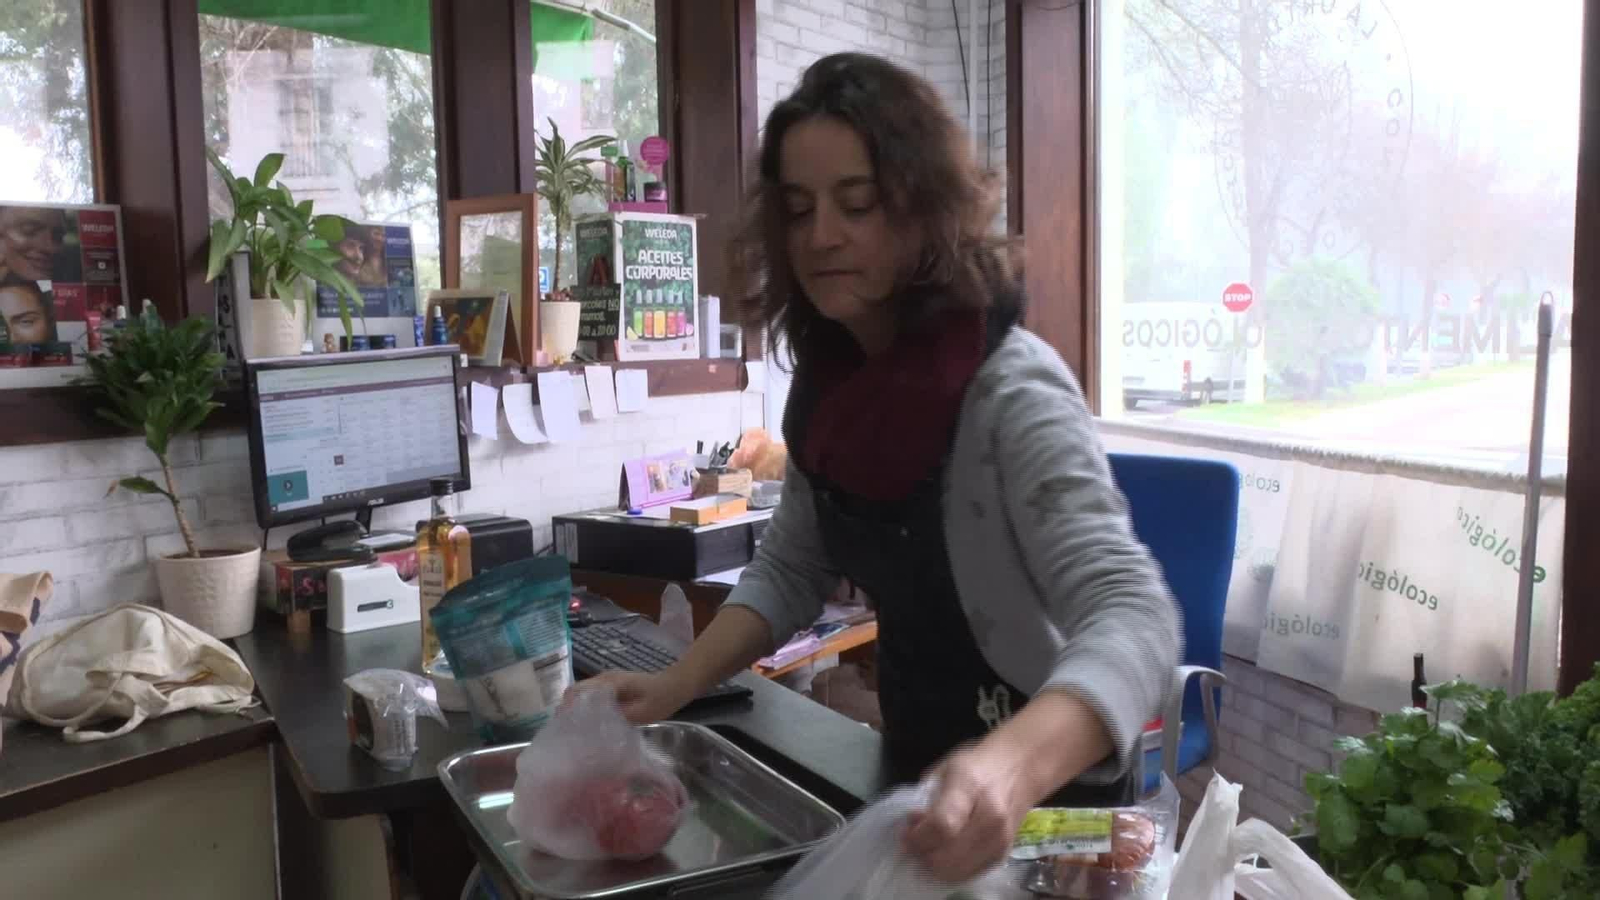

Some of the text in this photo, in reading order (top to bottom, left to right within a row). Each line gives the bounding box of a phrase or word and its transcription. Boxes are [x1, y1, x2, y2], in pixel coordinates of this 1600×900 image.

[644, 228, 677, 240] WELEDA
[638, 249, 684, 265] ACEITES
[626, 265, 693, 280] CORPORALES
[1224, 293, 1251, 303] STOP
